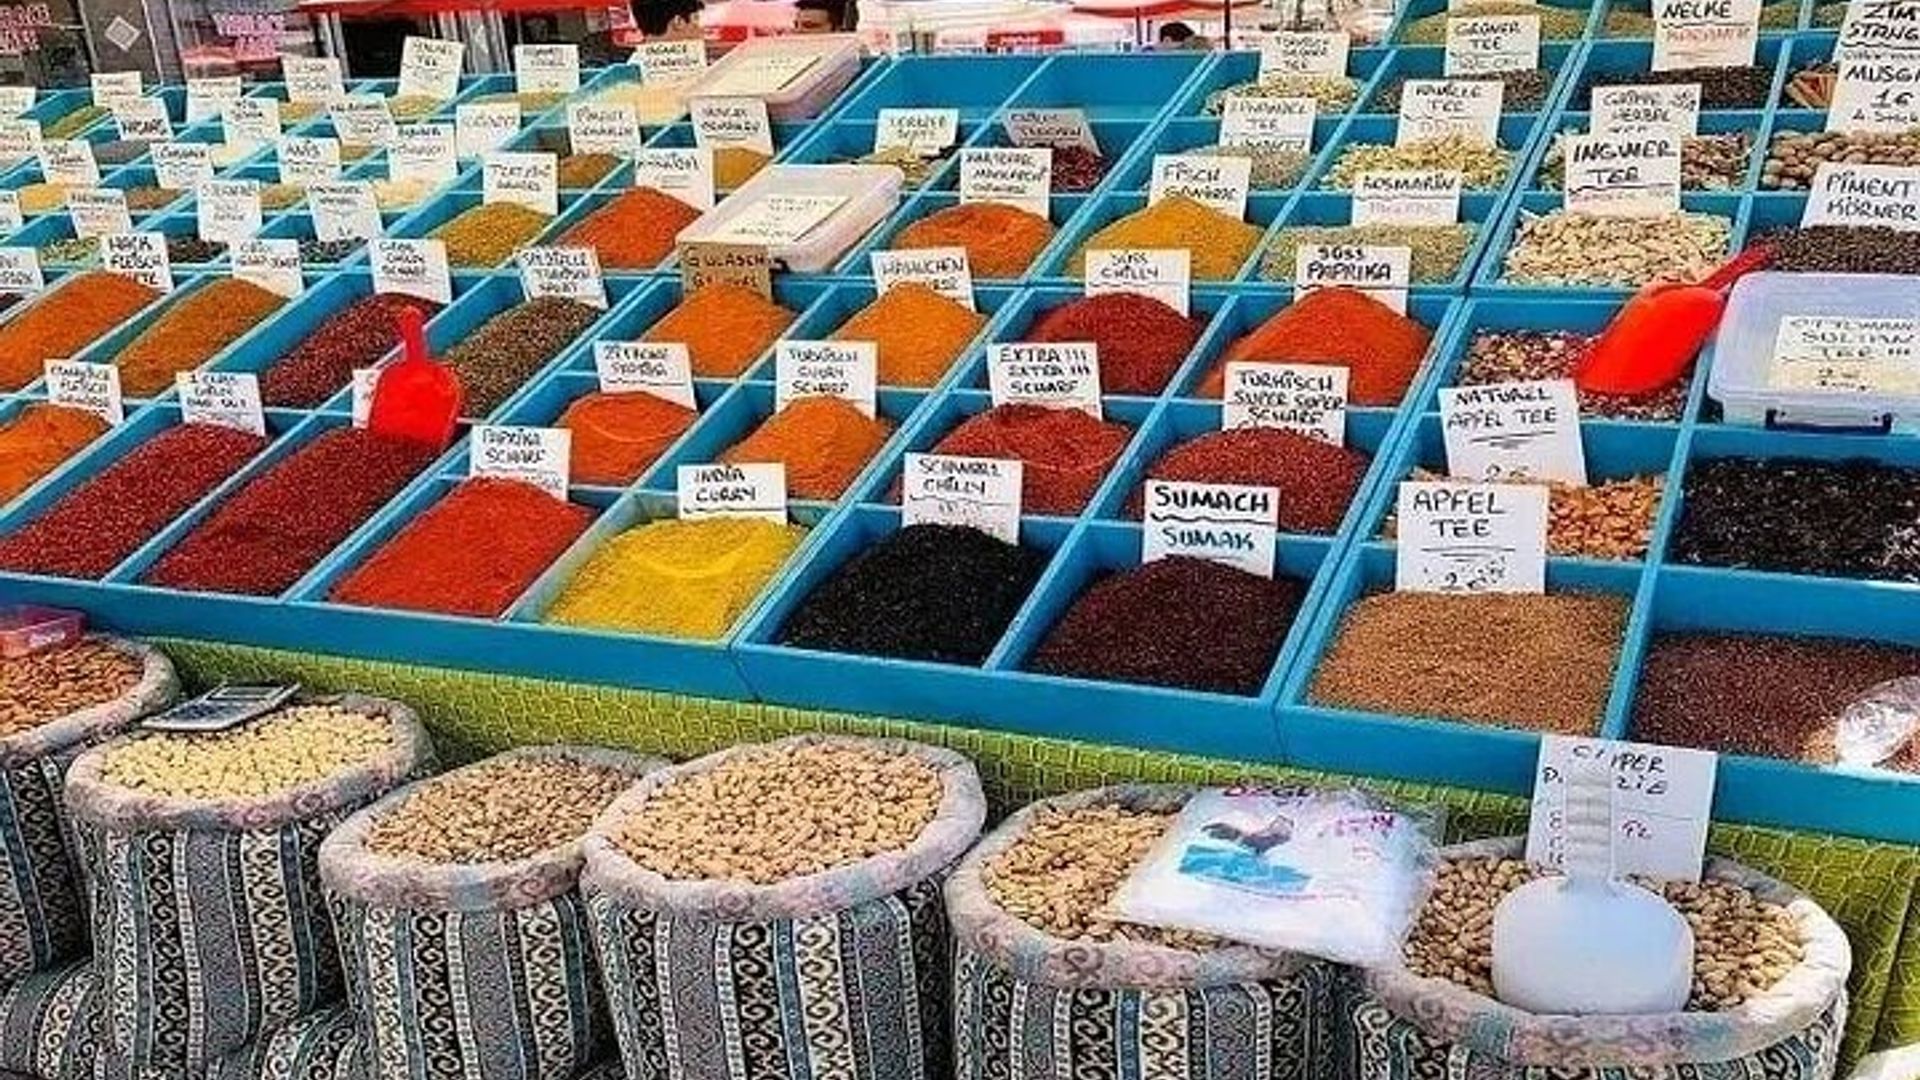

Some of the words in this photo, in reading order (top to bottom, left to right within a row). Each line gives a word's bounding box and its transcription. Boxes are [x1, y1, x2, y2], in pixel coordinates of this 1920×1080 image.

[1572, 139, 1678, 163] INGWER
[1306, 262, 1392, 282] PAPRIKA
[1000, 346, 1060, 364] EXTRA
[1514, 407, 1558, 425] TEE
[1154, 484, 1271, 514] SUMACH
[1413, 488, 1507, 516] APFEL
[1162, 525, 1256, 552] SUMAK
[1428, 517, 1493, 539] TEE
